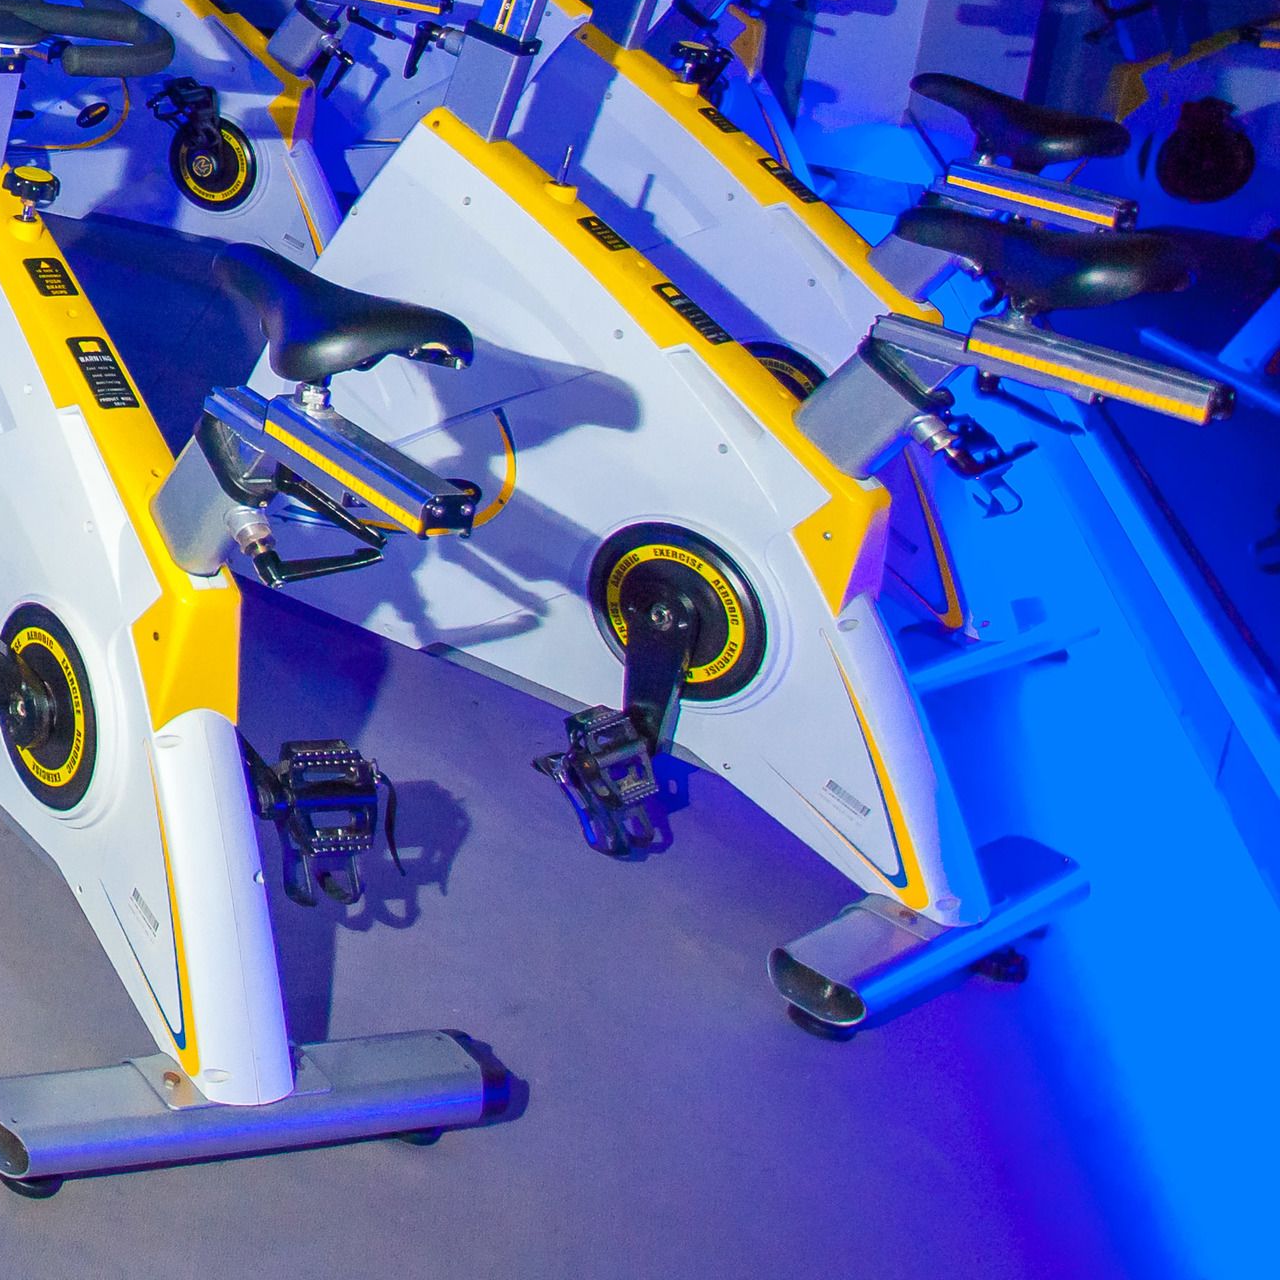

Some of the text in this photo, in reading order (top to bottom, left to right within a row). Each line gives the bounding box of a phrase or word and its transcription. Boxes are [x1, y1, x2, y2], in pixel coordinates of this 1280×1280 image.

[610, 554, 640, 588] AEROBIC
[653, 548, 704, 572] EXERCISE
[712, 578, 739, 626] AEROBIC
[26, 632, 54, 650] AEROBIC
[705, 641, 738, 677] EXERCISE
[62, 658, 81, 715] EXERCISE
[66, 731, 82, 774] AEROBIC
